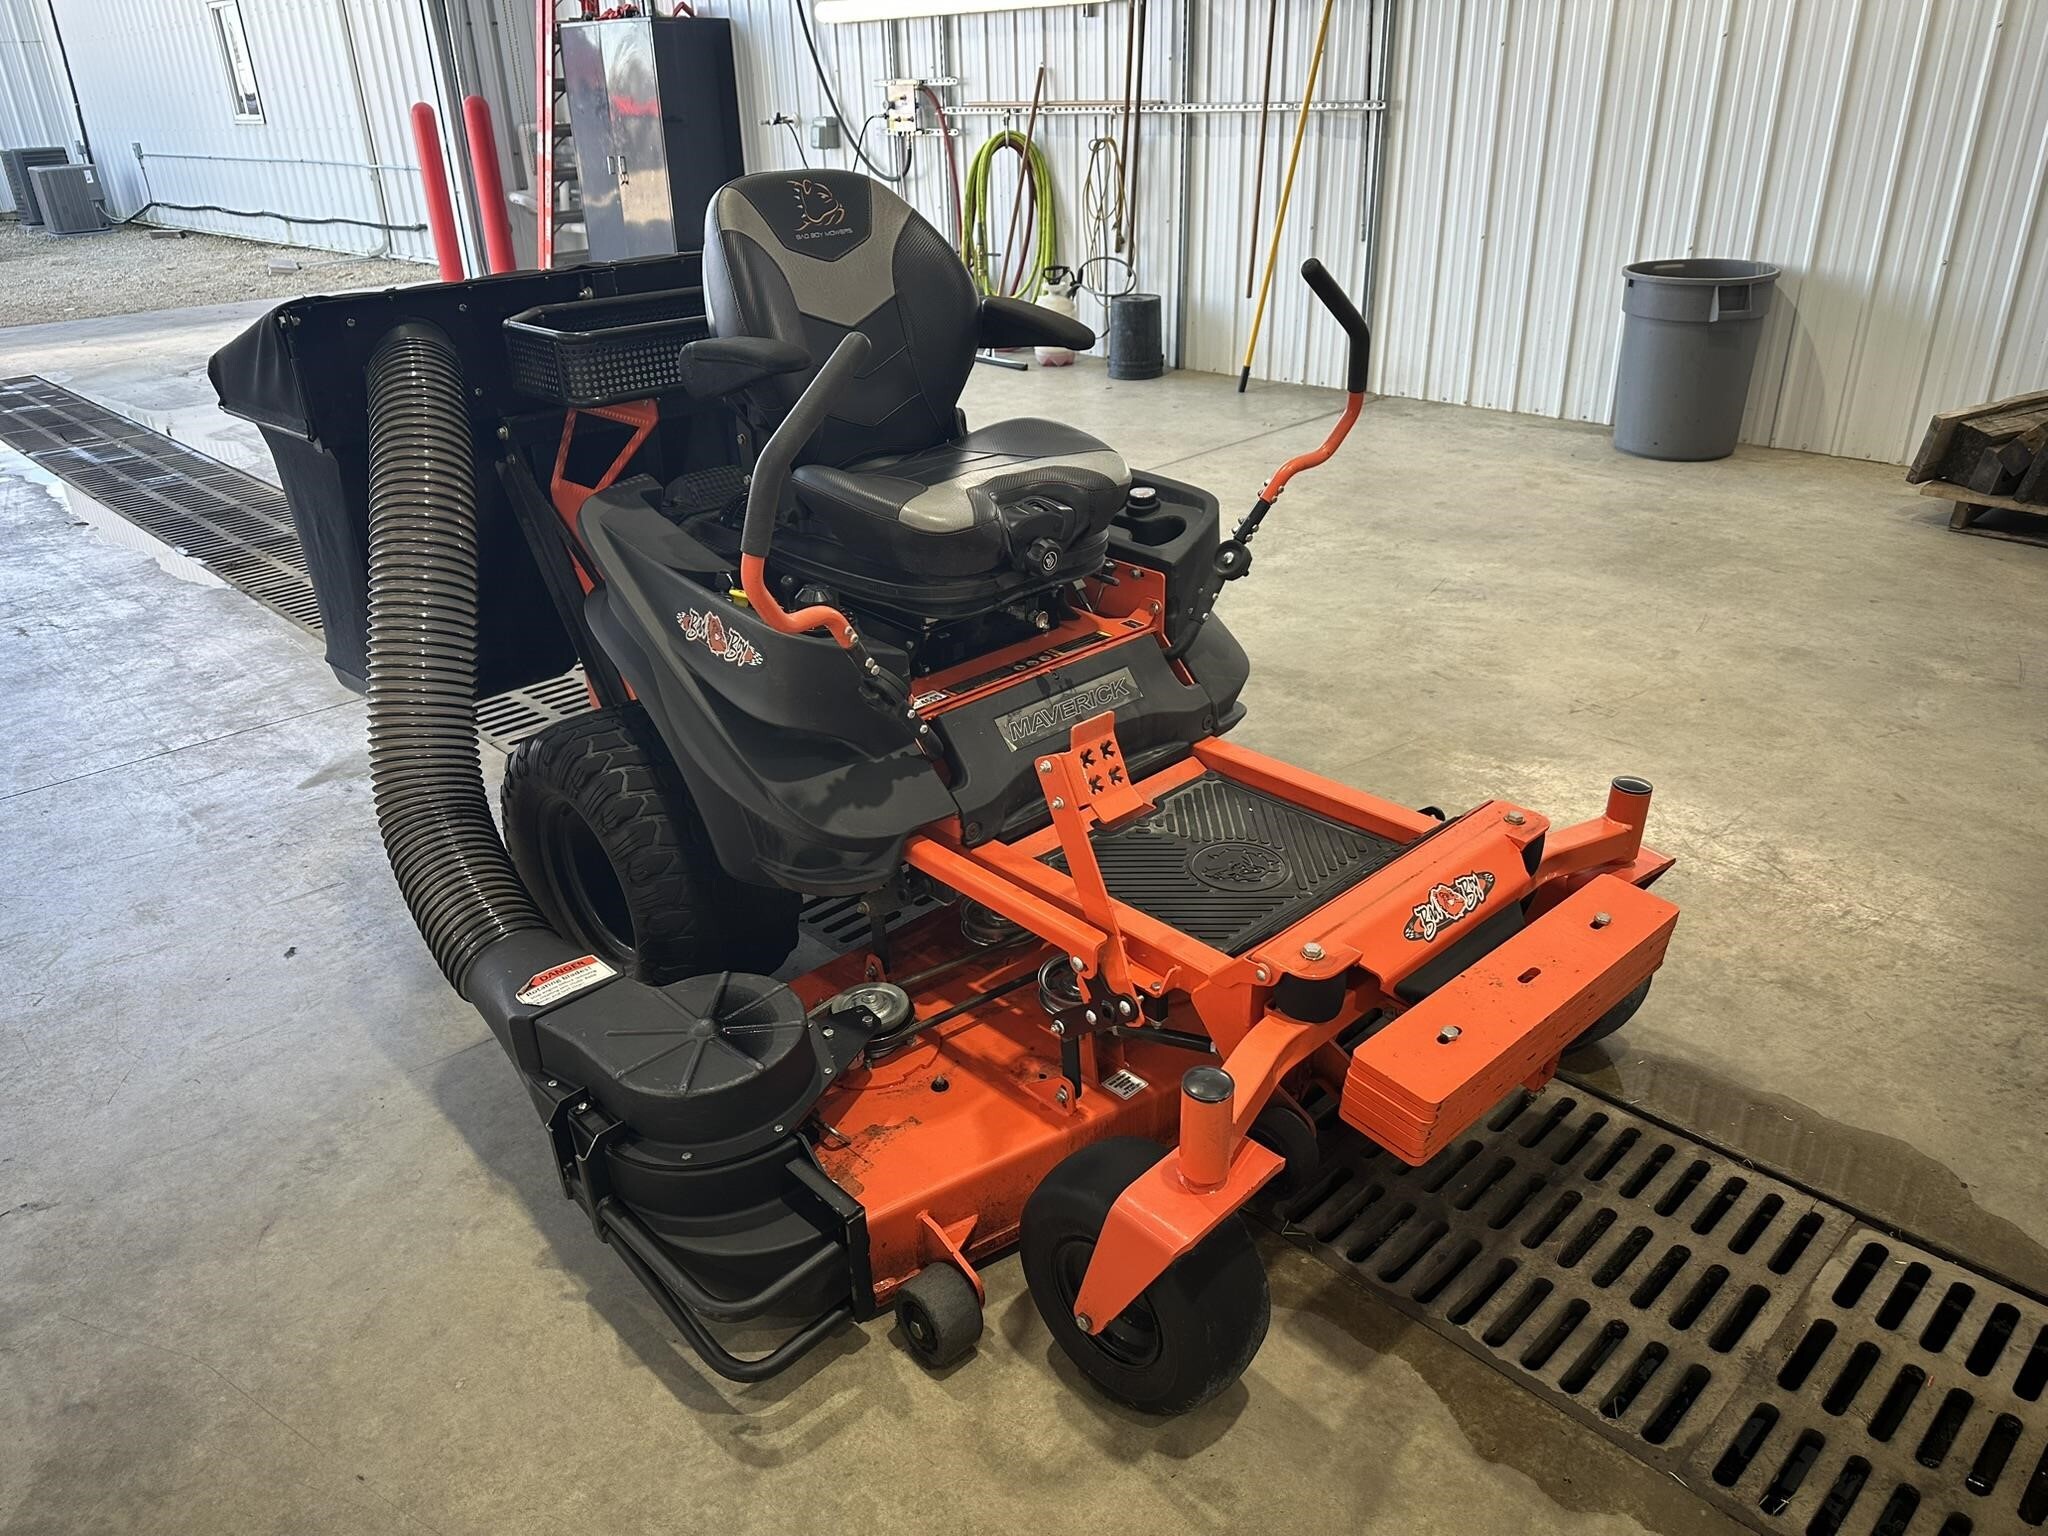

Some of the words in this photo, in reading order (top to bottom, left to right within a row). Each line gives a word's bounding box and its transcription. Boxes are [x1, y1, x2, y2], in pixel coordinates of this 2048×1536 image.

[810, 231, 823, 239] BOY
[1008, 676, 1130, 741] MAVERICK
[539, 960, 586, 982] DANGER
[526, 977, 562, 997] Rotating
